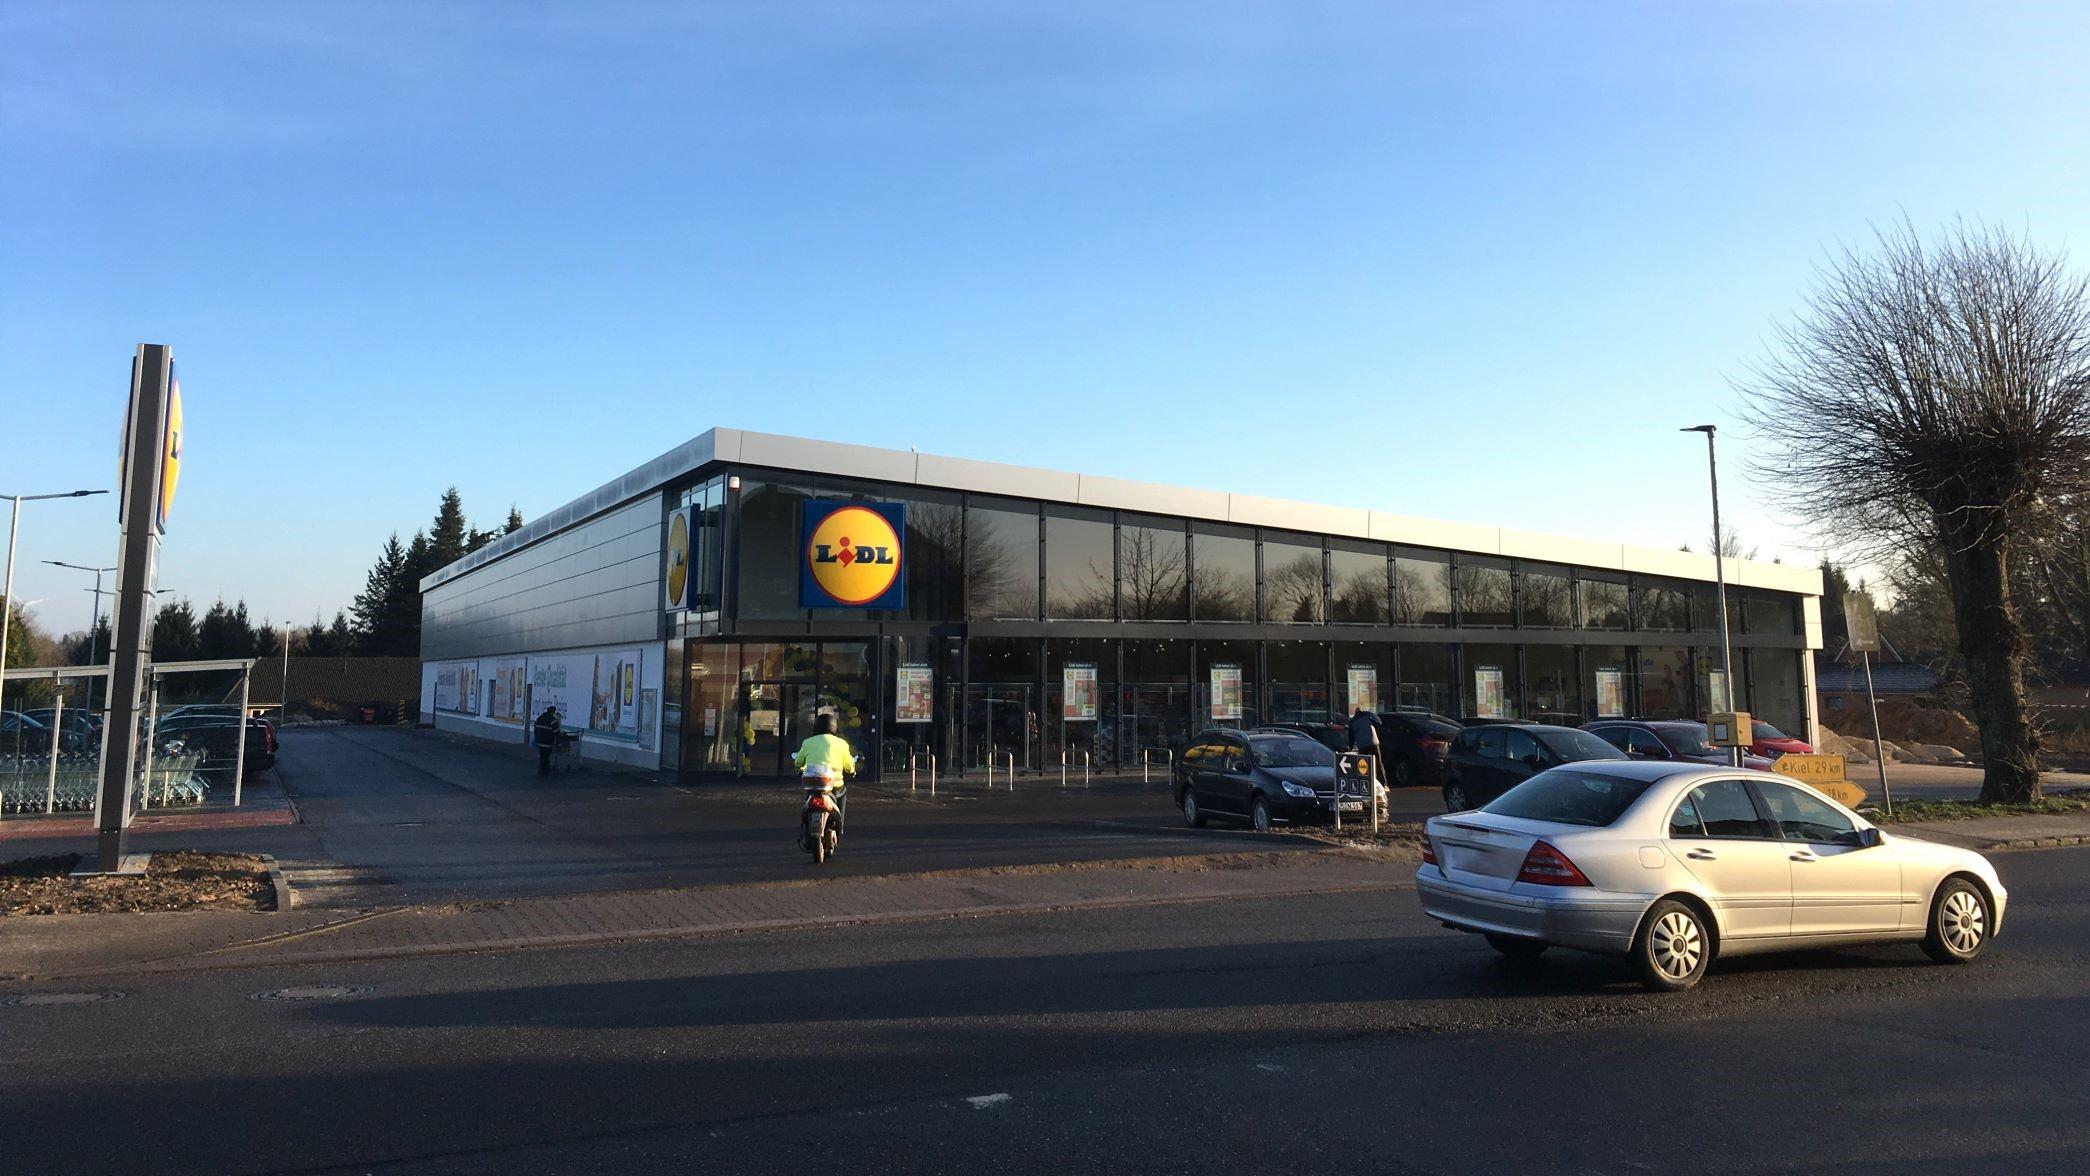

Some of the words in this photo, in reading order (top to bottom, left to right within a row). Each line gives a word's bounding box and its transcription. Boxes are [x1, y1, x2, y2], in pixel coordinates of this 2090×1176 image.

[1790, 761, 1810, 774] Kiel
[1815, 761, 1827, 774] 29
[1829, 763, 1841, 774] km
[1837, 790, 1849, 801] km
